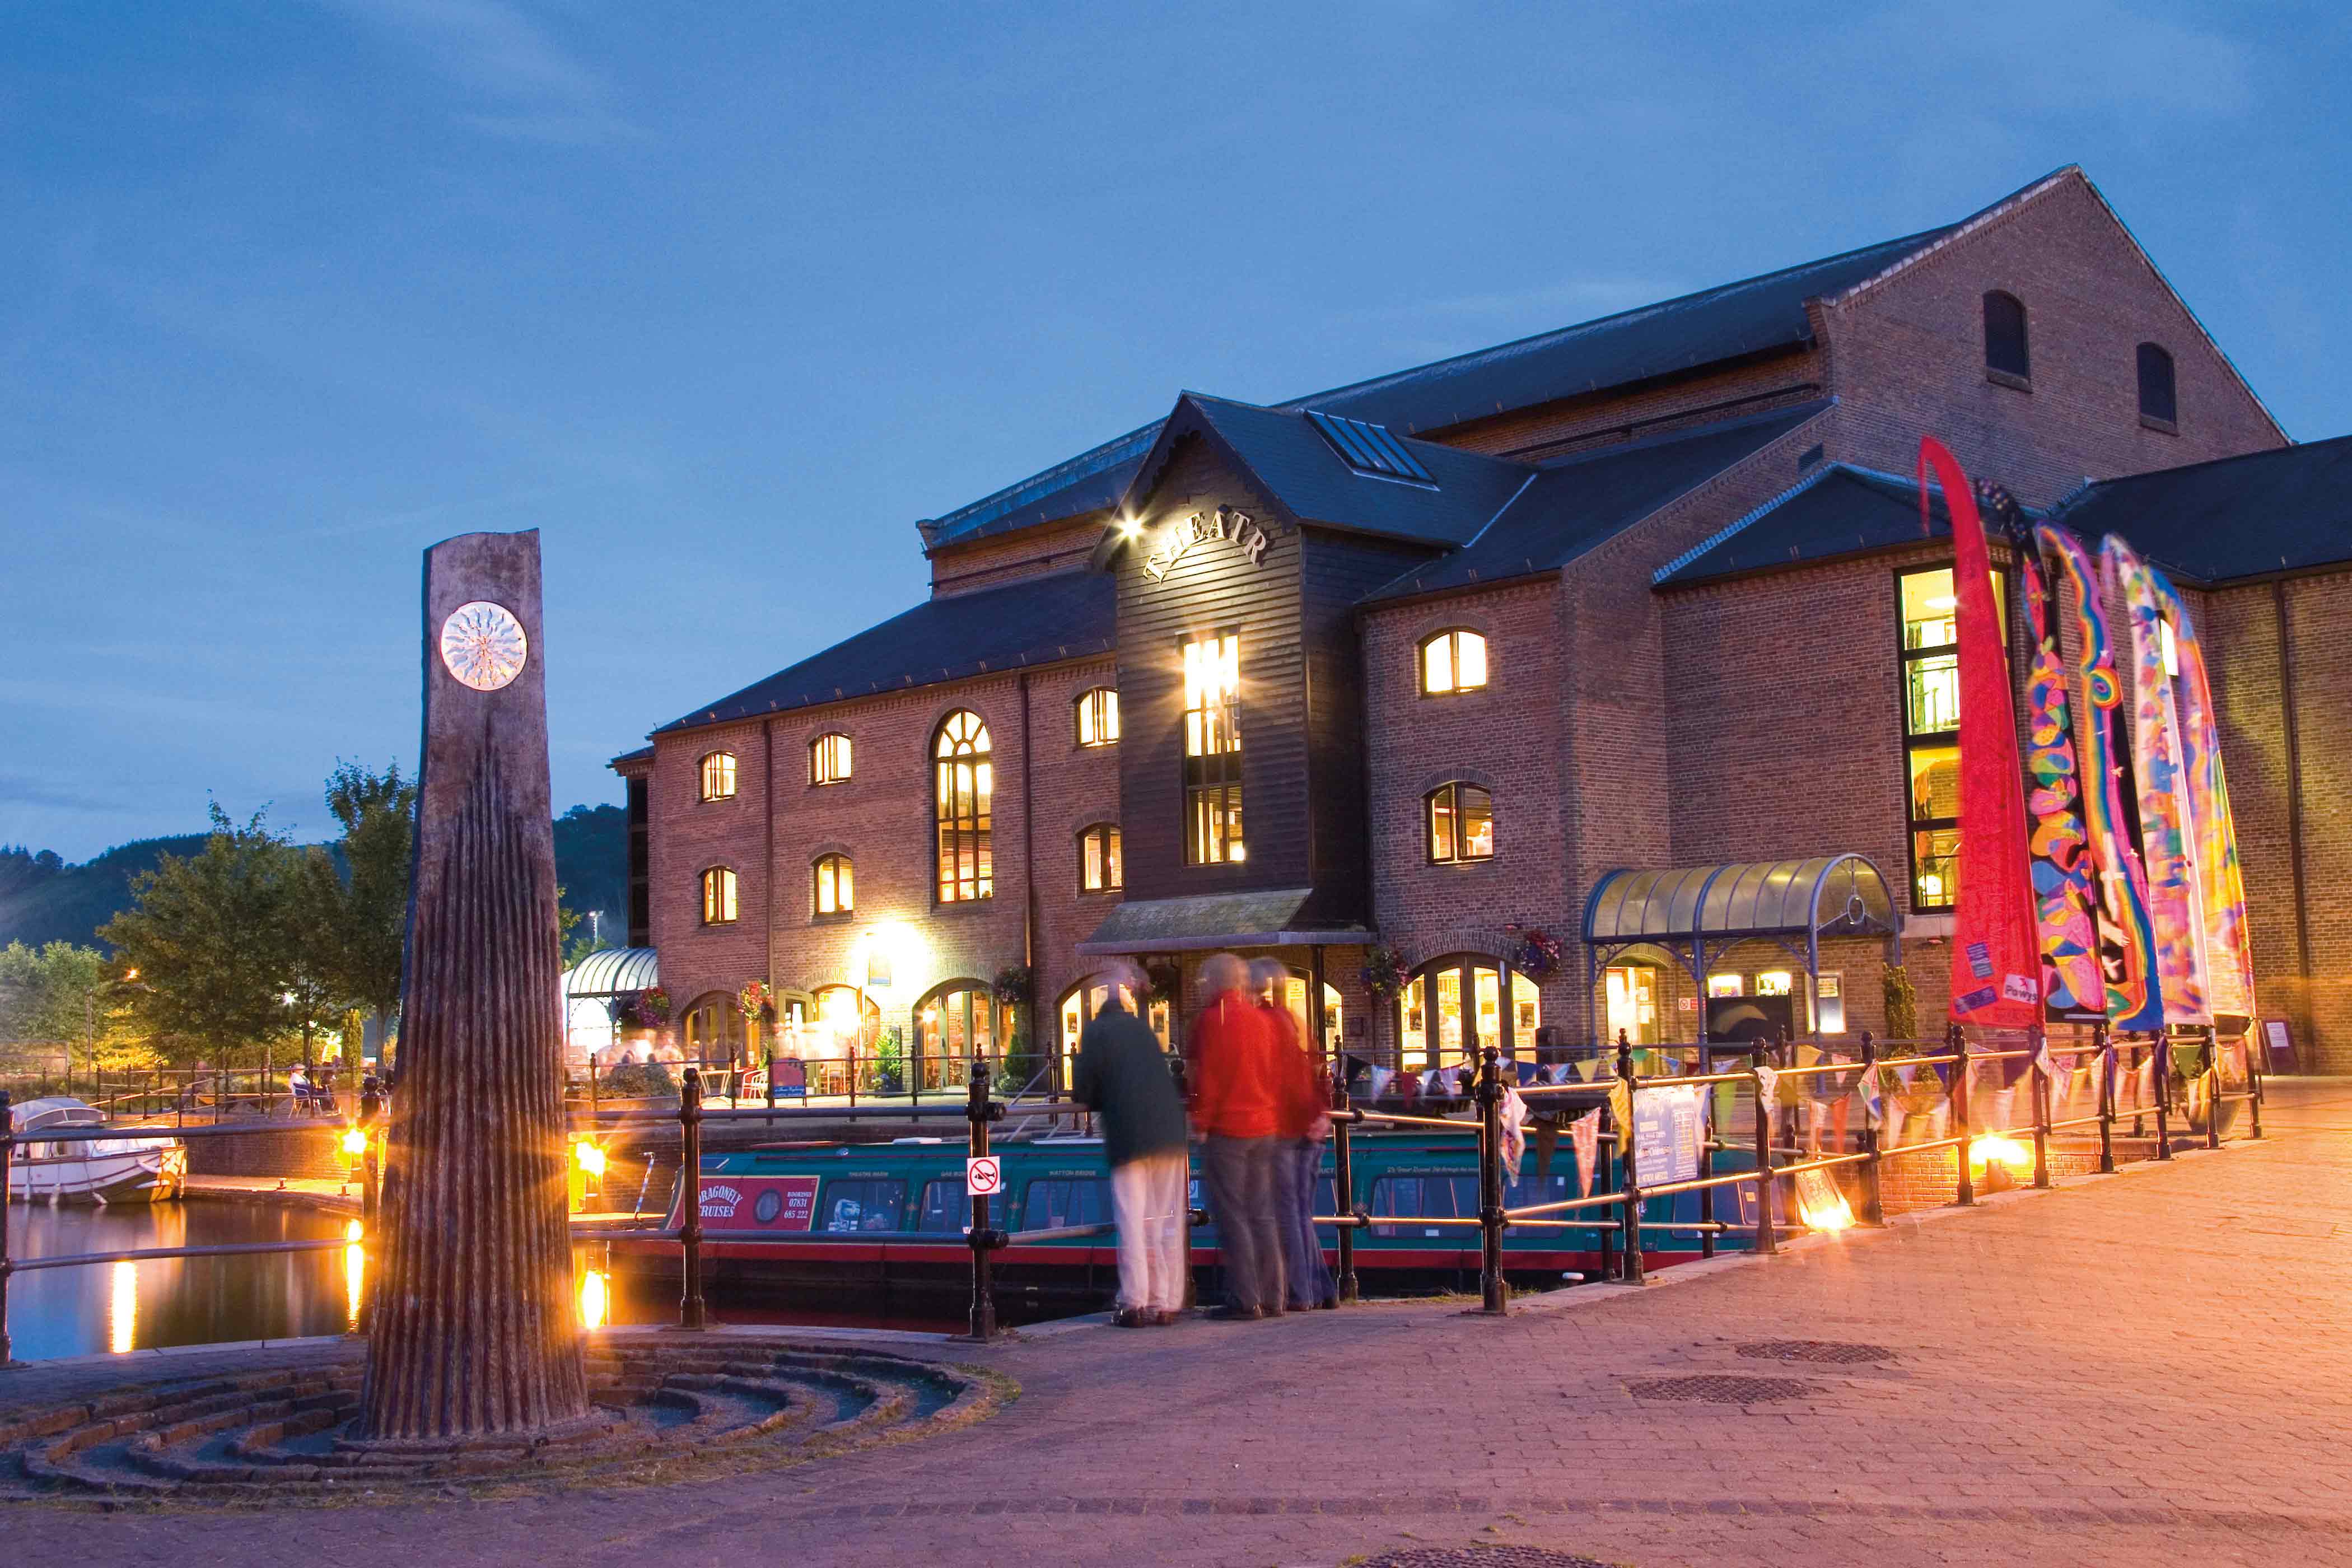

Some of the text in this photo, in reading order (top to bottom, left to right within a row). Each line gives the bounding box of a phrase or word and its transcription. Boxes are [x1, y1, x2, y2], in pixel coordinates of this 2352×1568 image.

[2005, 985, 2037, 1001] Powys
[699, 1205, 735, 1217] RUISES
[797, 1210, 808, 1219] 222
